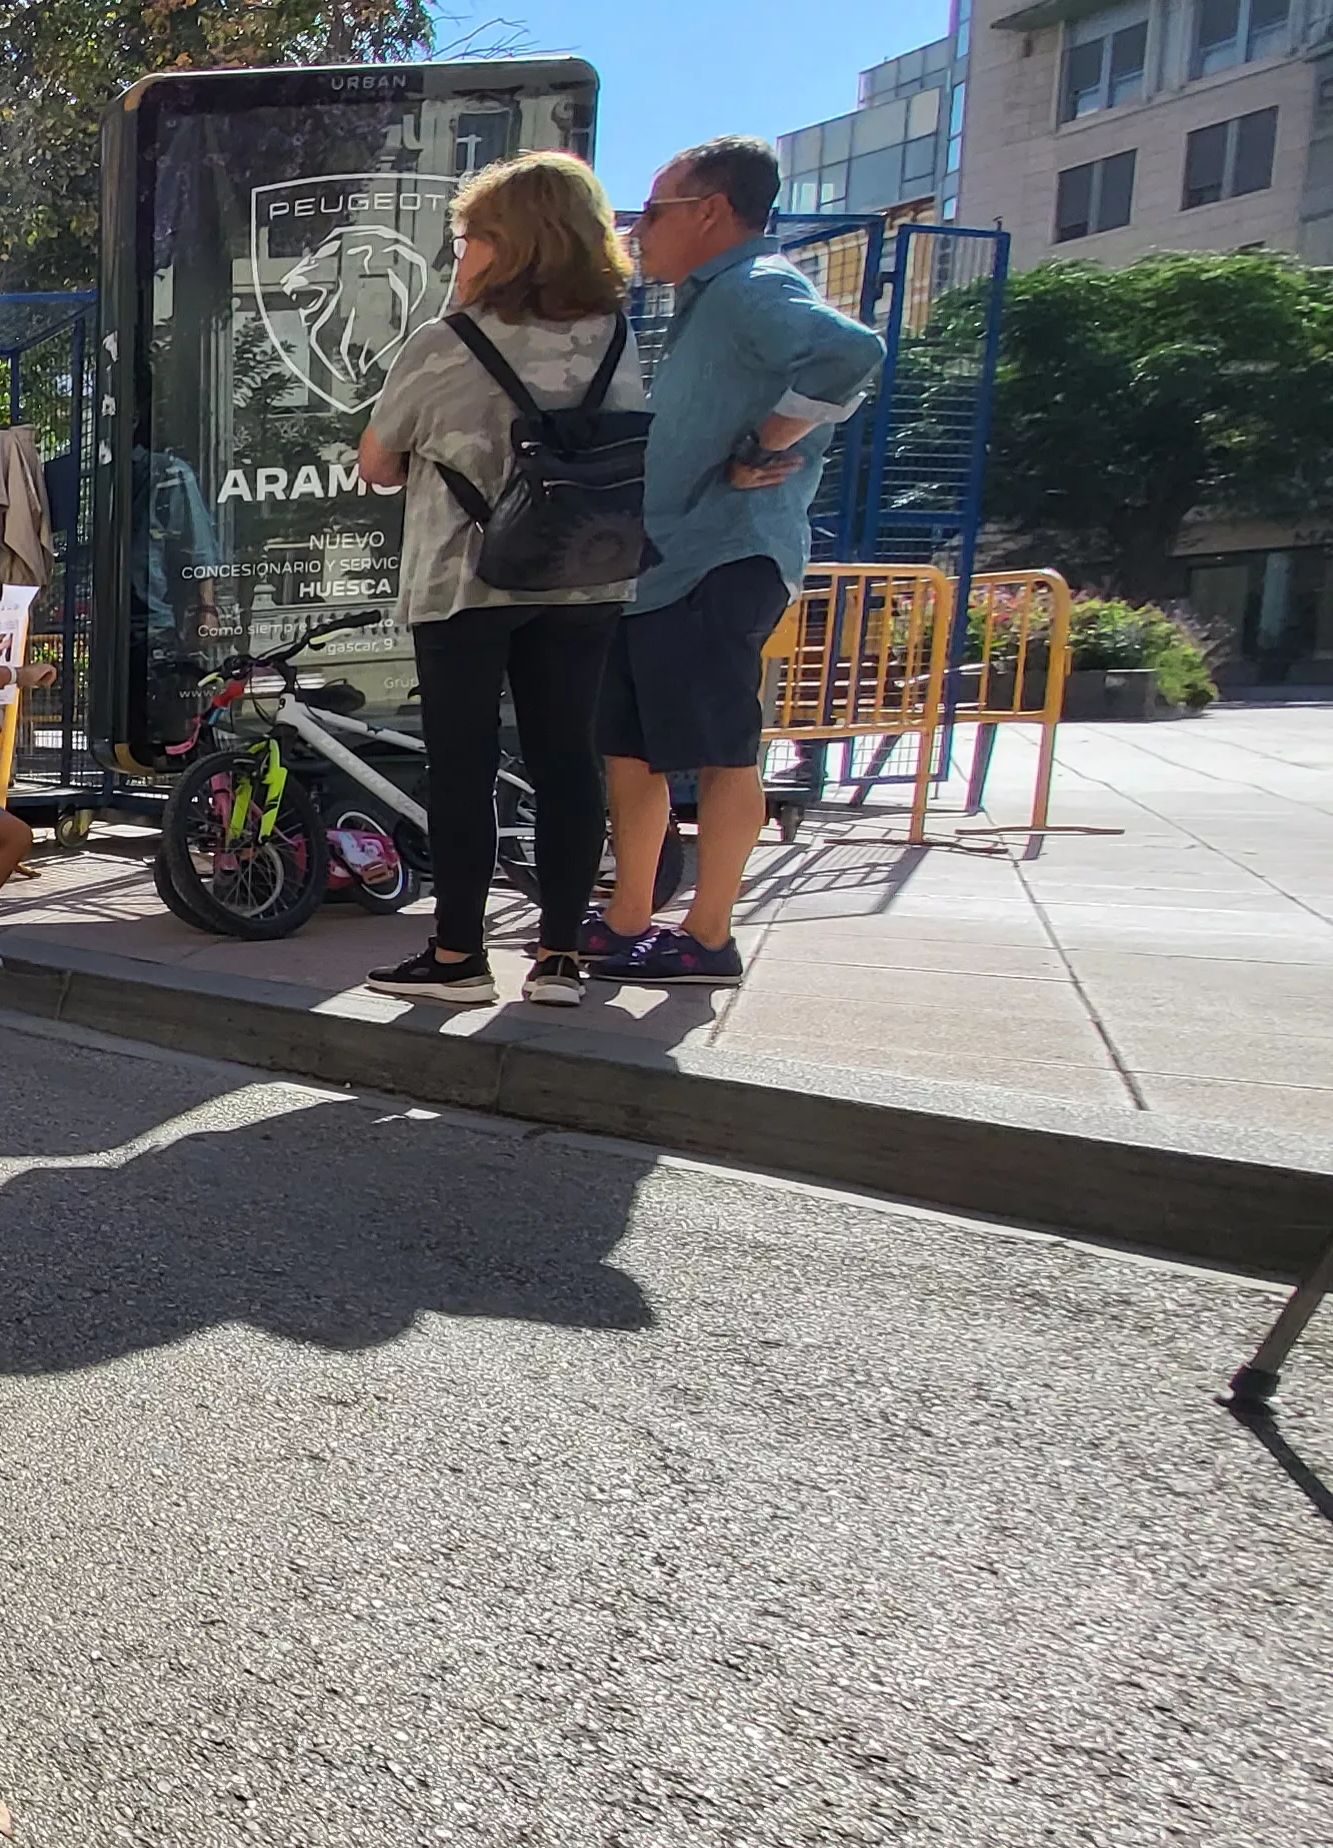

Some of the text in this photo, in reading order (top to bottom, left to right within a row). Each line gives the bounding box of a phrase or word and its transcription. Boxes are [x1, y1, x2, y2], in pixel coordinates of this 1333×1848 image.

[331, 75, 407, 90] URBAN
[269, 193, 446, 220] PEUGEOT
[309, 531, 385, 550] NUEVO
[181, 559, 321, 580] CONCESIONARIO
[325, 560, 334, 572] Y
[299, 578, 392, 599] HUESCA
[197, 623, 243, 637] Como
[247, 619, 308, 635] siempre
[383, 637, 394, 651] 9
